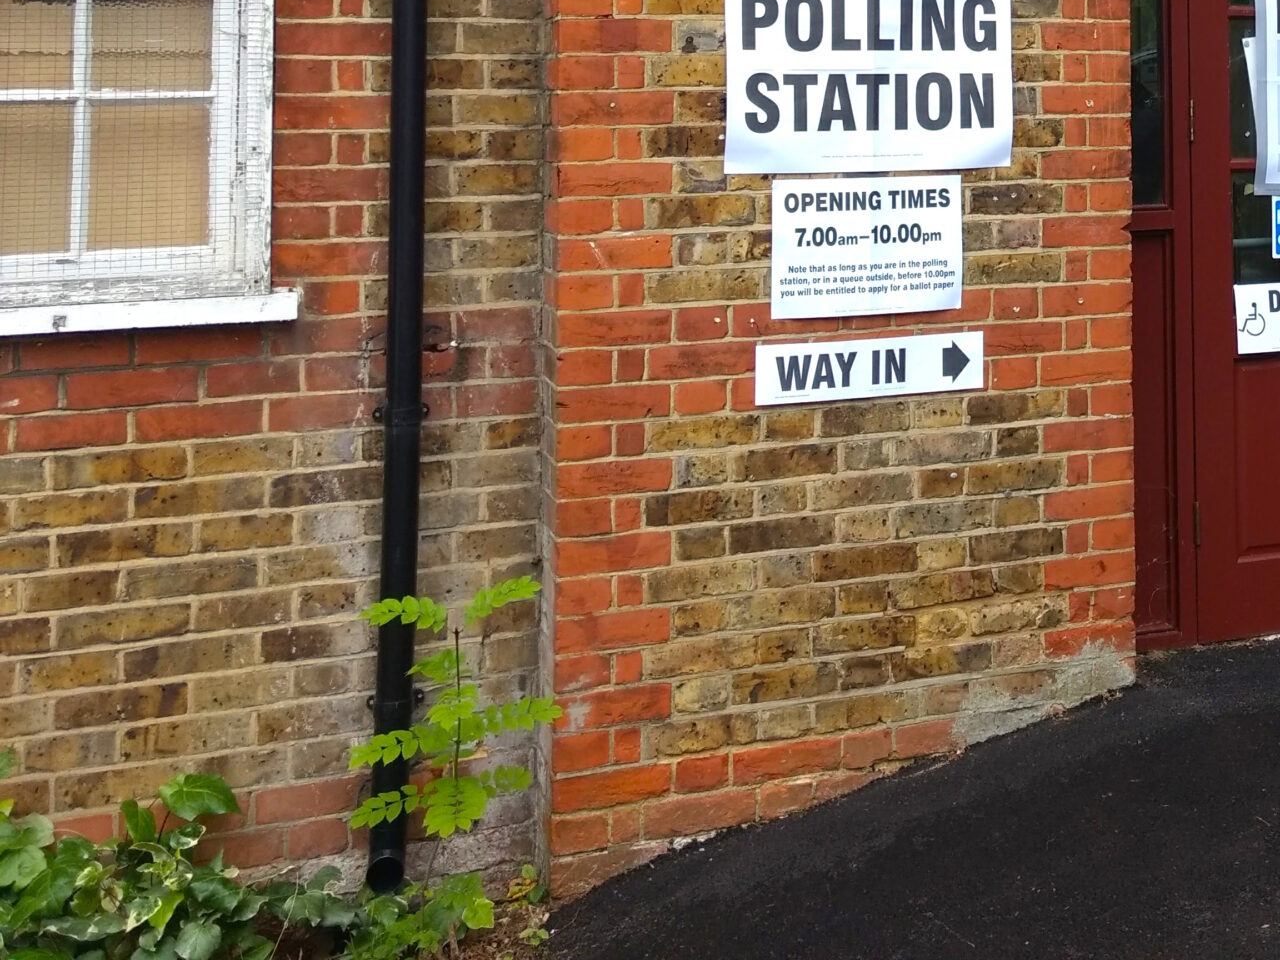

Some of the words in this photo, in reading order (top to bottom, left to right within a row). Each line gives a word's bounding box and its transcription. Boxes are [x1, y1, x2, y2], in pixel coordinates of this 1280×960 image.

[744, 72, 995, 133] STATION
[784, 190, 882, 213] OPENING
[888, 188, 951, 209] TIMES
[788, 265, 807, 274] Note
[809, 264, 825, 273] that
[839, 263, 855, 273] long
[858, 263, 867, 271] as
[870, 263, 882, 272] you
[899, 260, 906, 268] in
[908, 260, 920, 268] the
[922, 259, 948, 269] polling
[780, 277, 810, 286] station,
[840, 275, 863, 284] queue
[866, 272, 896, 282] outside,
[898, 271, 922, 280] before
[924, 270, 955, 279] 10.00pm
[780, 289, 795, 298] you
[797, 287, 811, 296] will
[814, 288, 823, 296] be
[826, 285, 856, 295] entitled
[858, 285, 865, 293] to
[868, 283, 888, 294] apply
[890, 282, 900, 291] for
[903, 283, 908, 291] a
[910, 281, 931, 290] ballot
[933, 281, 954, 290] paper
[775, 351, 857, 392] WAY
[870, 348, 907, 385] IN
